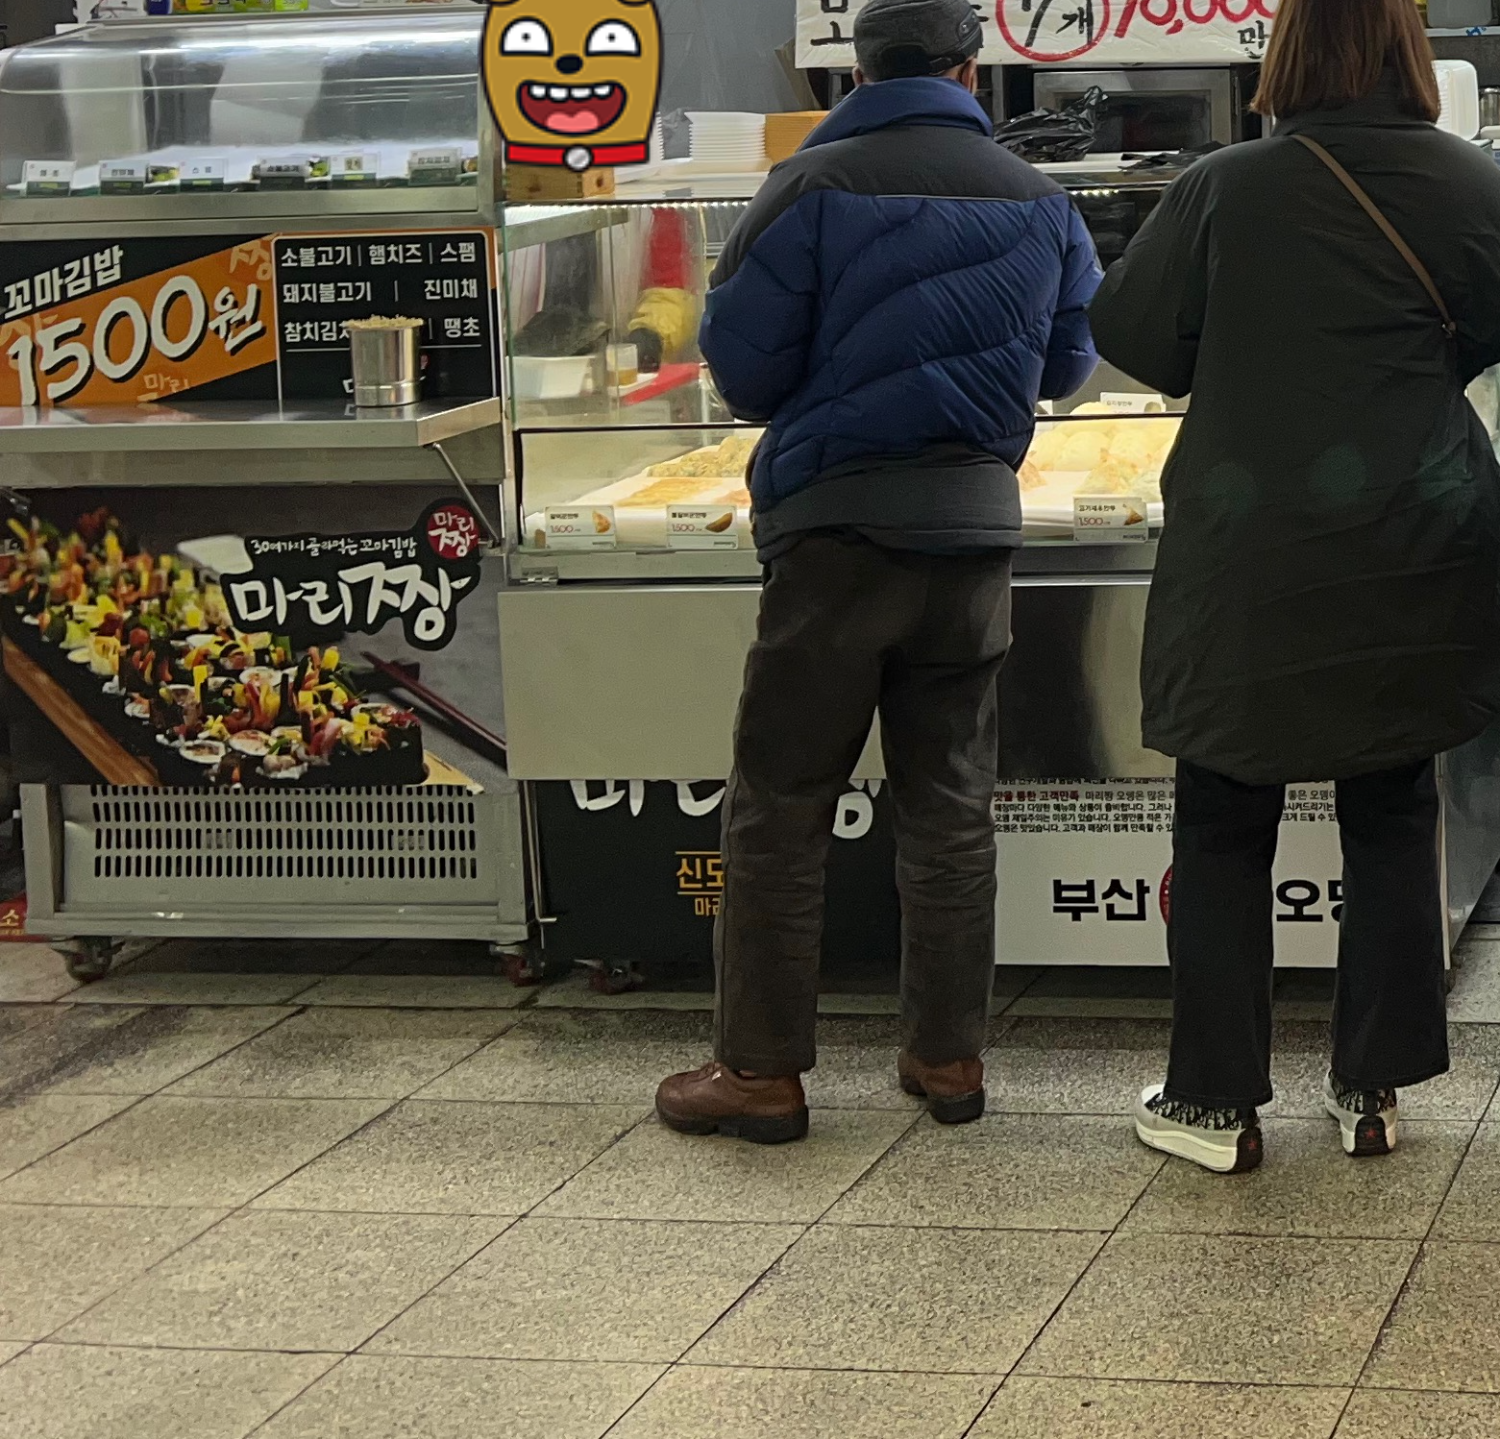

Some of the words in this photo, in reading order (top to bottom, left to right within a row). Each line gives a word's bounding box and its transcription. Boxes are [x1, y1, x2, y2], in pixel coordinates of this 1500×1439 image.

[281, 246, 352, 267] 소불고기
[369, 243, 422, 265] 햄치즈
[440, 242, 476, 263] 스팸
[4, 244, 124, 320] 꼬마김밥
[283, 281, 372, 304] 돼지불고기
[424, 278, 479, 301] 진미채
[444, 317, 481, 338] 땡초
[433, 512, 474, 532] 마리
[251, 537, 304, 555] 30여가지
[306, 537, 358, 557] 골라먹는
[360, 537, 418, 559] 꼬마김밥
[230, 561, 473, 641] 마리짱
[1040, 790, 1079, 801] 고객만족
[1053, 878, 1150, 922] 부산
